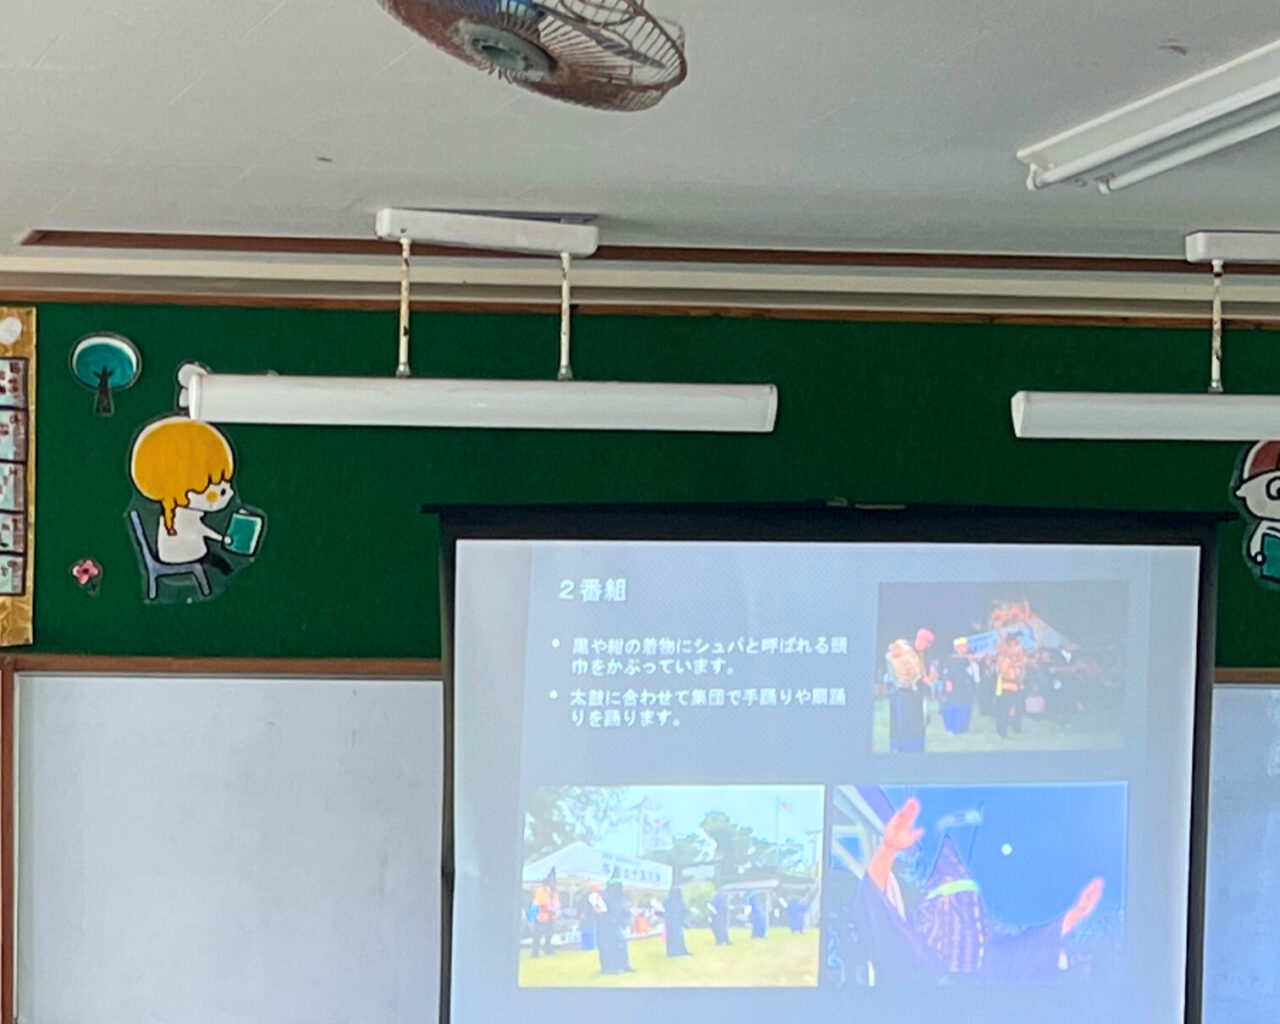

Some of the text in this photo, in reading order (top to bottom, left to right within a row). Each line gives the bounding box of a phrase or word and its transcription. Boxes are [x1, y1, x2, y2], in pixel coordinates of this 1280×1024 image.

[571, 658, 735, 676] 巾をかぶっています。
[571, 709, 682, 728] りを踊ります。
